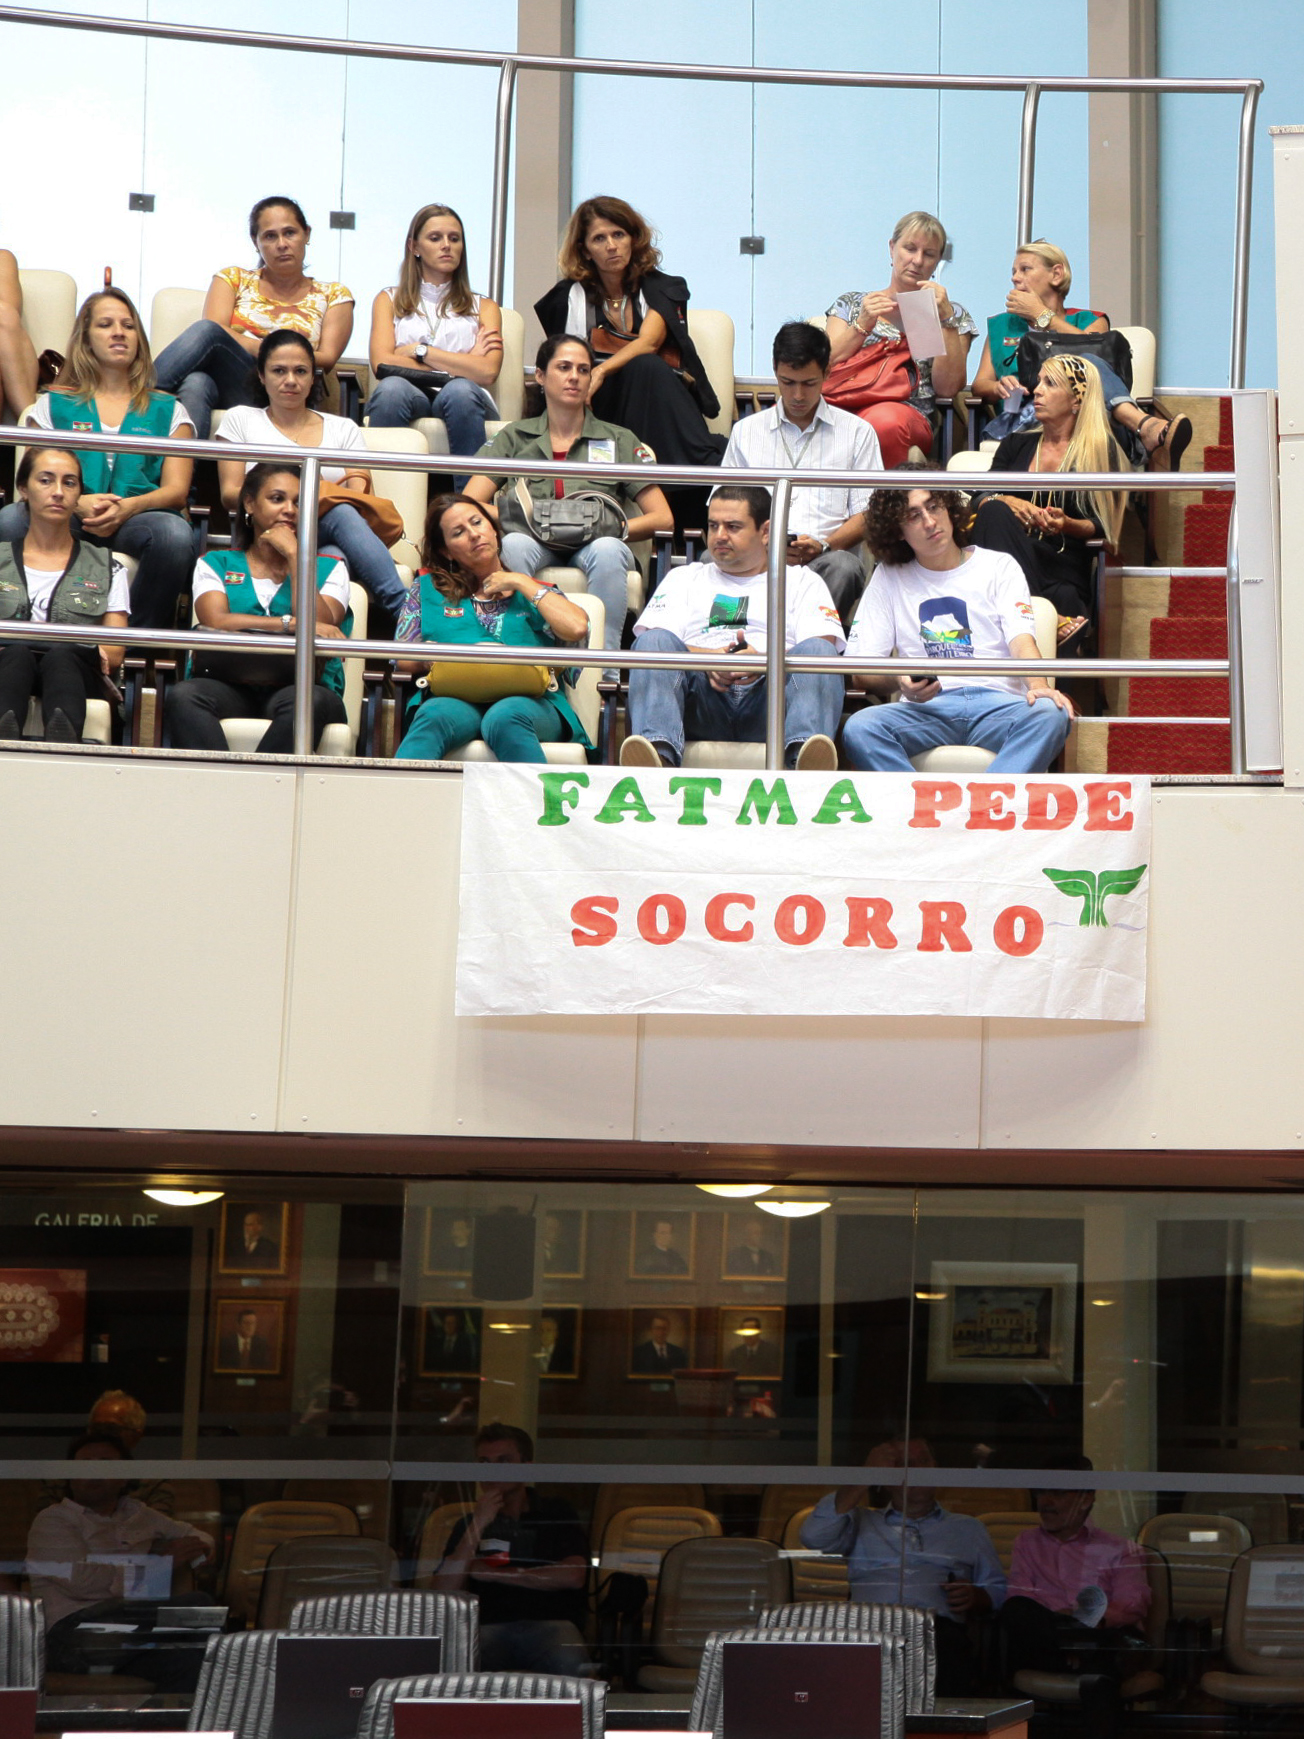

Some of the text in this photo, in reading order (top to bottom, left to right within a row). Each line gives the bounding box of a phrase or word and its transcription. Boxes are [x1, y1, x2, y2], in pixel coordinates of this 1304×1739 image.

[537, 771, 1134, 832] FATMA PEDE
[570, 892, 1045, 957] SOCORRO
